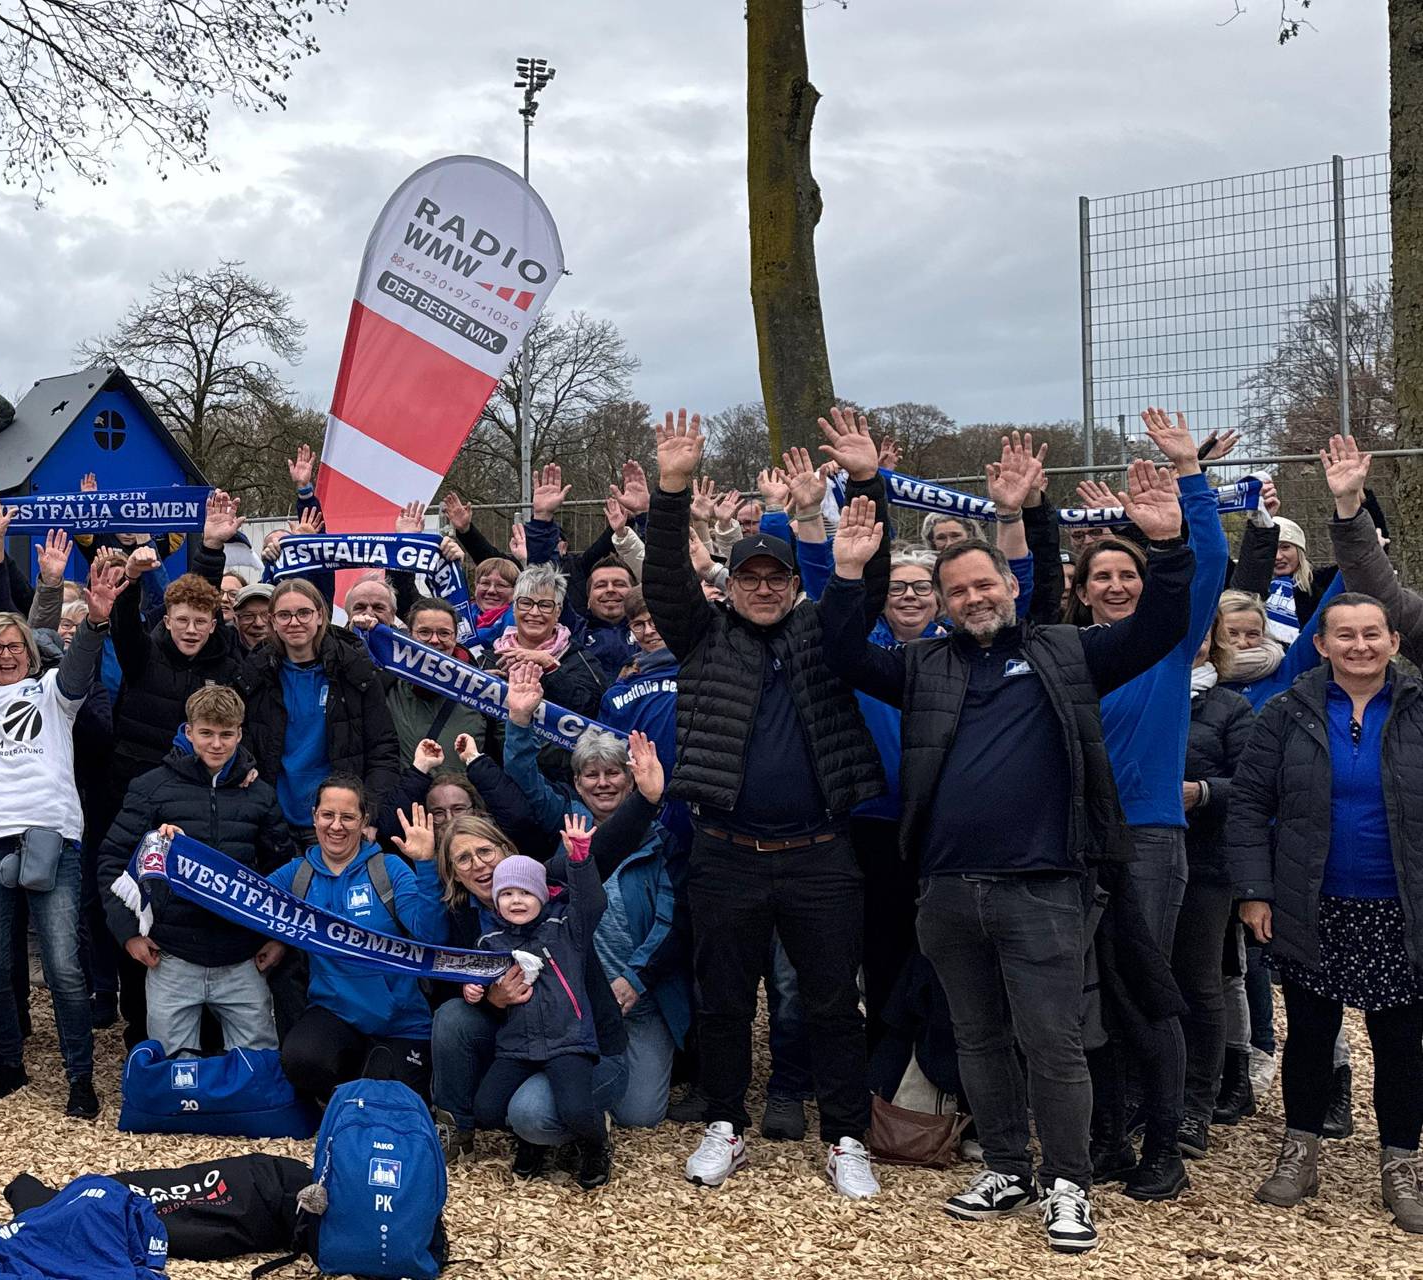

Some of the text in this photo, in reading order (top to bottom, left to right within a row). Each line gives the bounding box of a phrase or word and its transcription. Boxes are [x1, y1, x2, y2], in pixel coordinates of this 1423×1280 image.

[403, 222, 482, 279] WMW
[414, 197, 548, 285] RADIO
[384, 277, 499, 350] DER BESTE MIX.
[36, 492, 147, 502] SPORTVEREIN
[890, 477, 997, 515] WESTFA
[120, 502, 199, 519] GEMEN
[74, 520, 109, 529] 1927
[460, 695, 478, 707] WIR
[479, 702, 501, 716] VON
[612, 680, 659, 710] Westfalia
[177, 854, 426, 964] WESTFALIA GEMEN
[267, 918, 308, 942] 1927
[180, 1099, 199, 1111] 20
[373, 1141, 395, 1151] JAKO
[129, 1170, 220, 1197] RADIO
[147, 1193, 187, 1204] MW
[375, 1193, 393, 1213] PK
